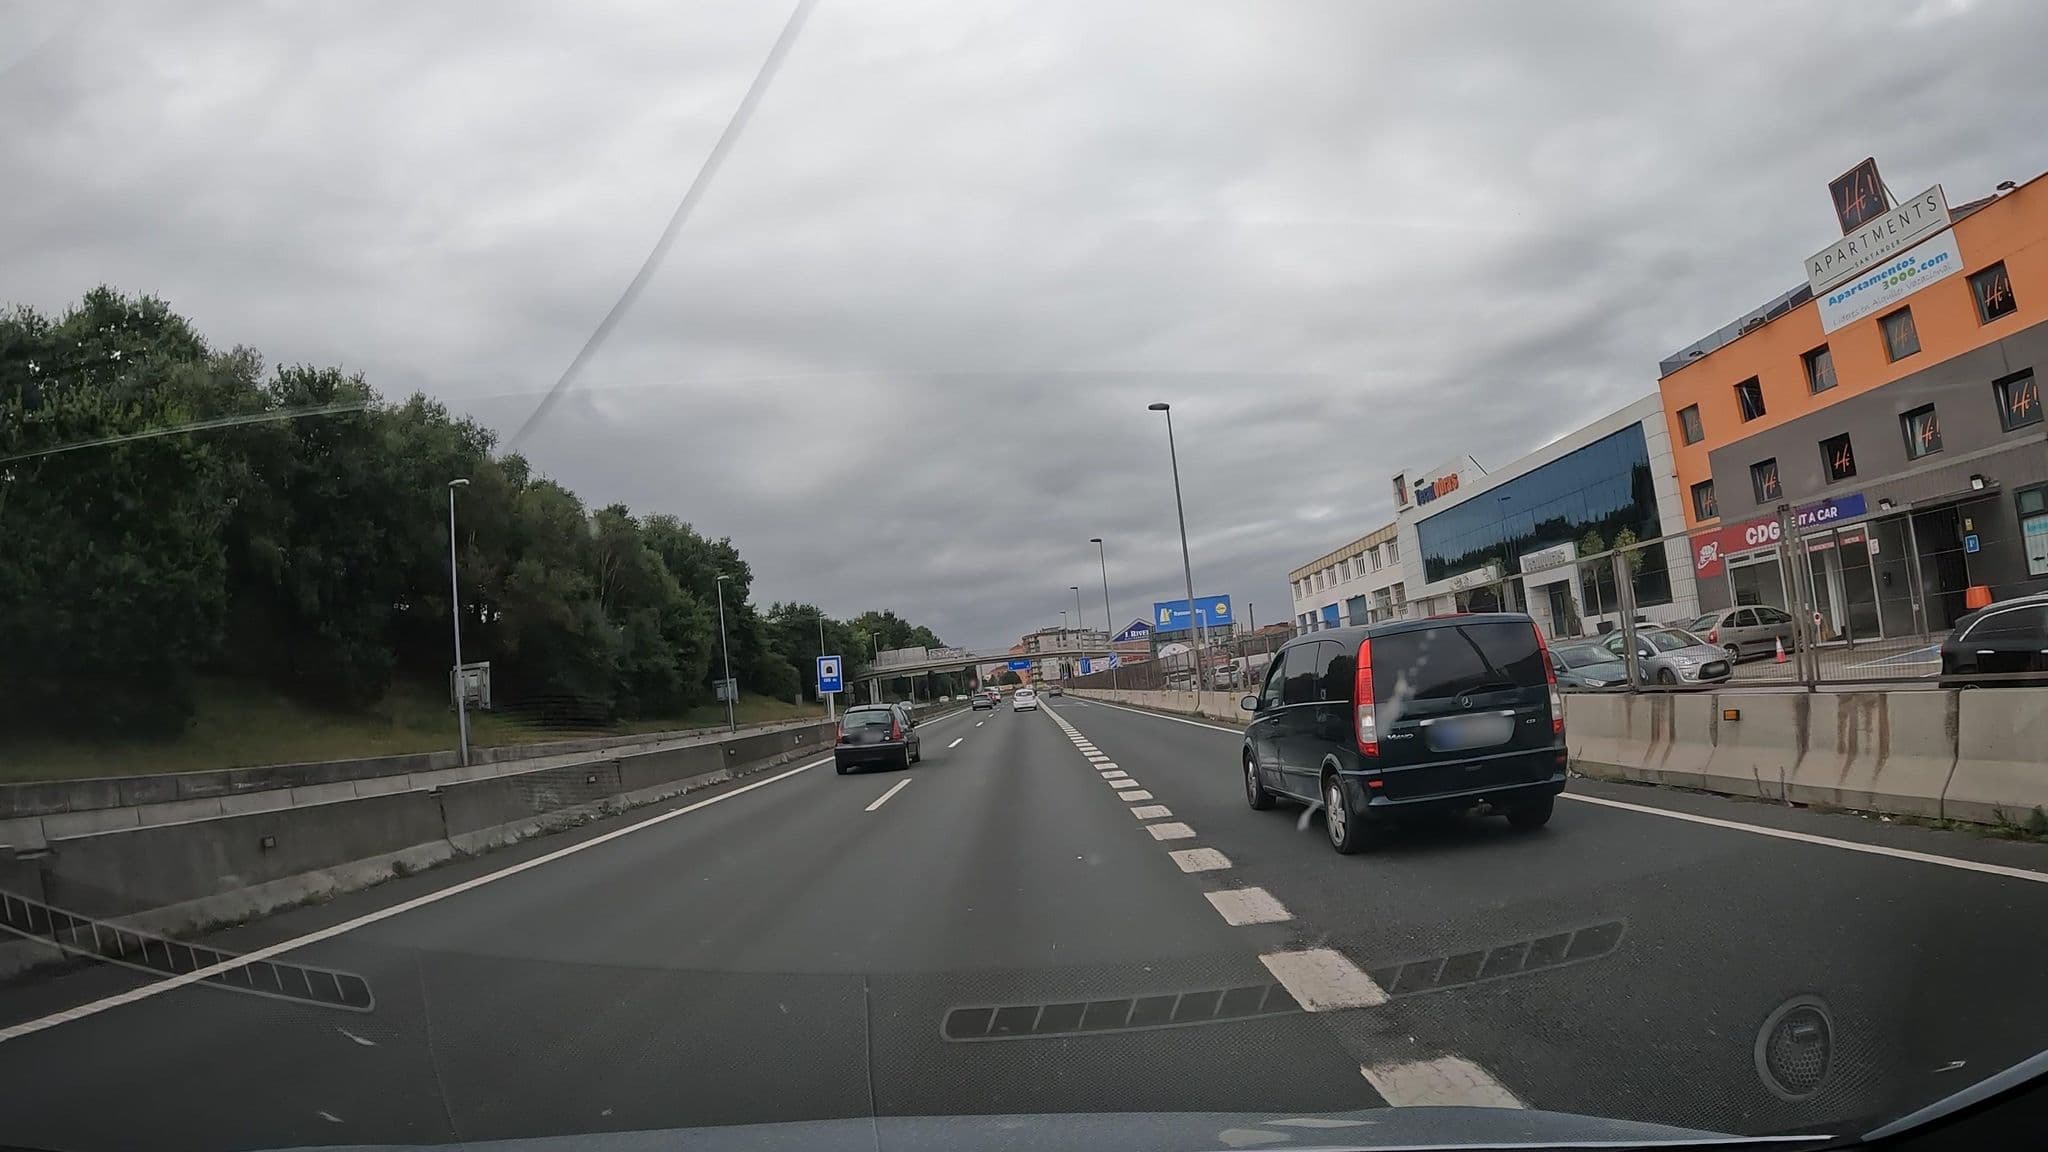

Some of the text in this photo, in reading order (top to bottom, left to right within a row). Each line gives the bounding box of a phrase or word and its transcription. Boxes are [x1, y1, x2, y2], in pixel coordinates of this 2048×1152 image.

[1843, 170, 1878, 223] Hi!
[1813, 195, 1937, 277] APARTMENTS
[1854, 239, 1901, 268] SANTANDER
[1828, 255, 1916, 307] Apartamentos
[1882, 251, 1949, 290] 3000.com
[1985, 274, 2012, 310] Hi!
[2011, 382, 2039, 418] Hi!
[1745, 521, 1780, 545] CDG
[1808, 511, 1816, 524] A
[1817, 506, 1838, 521] CAR
